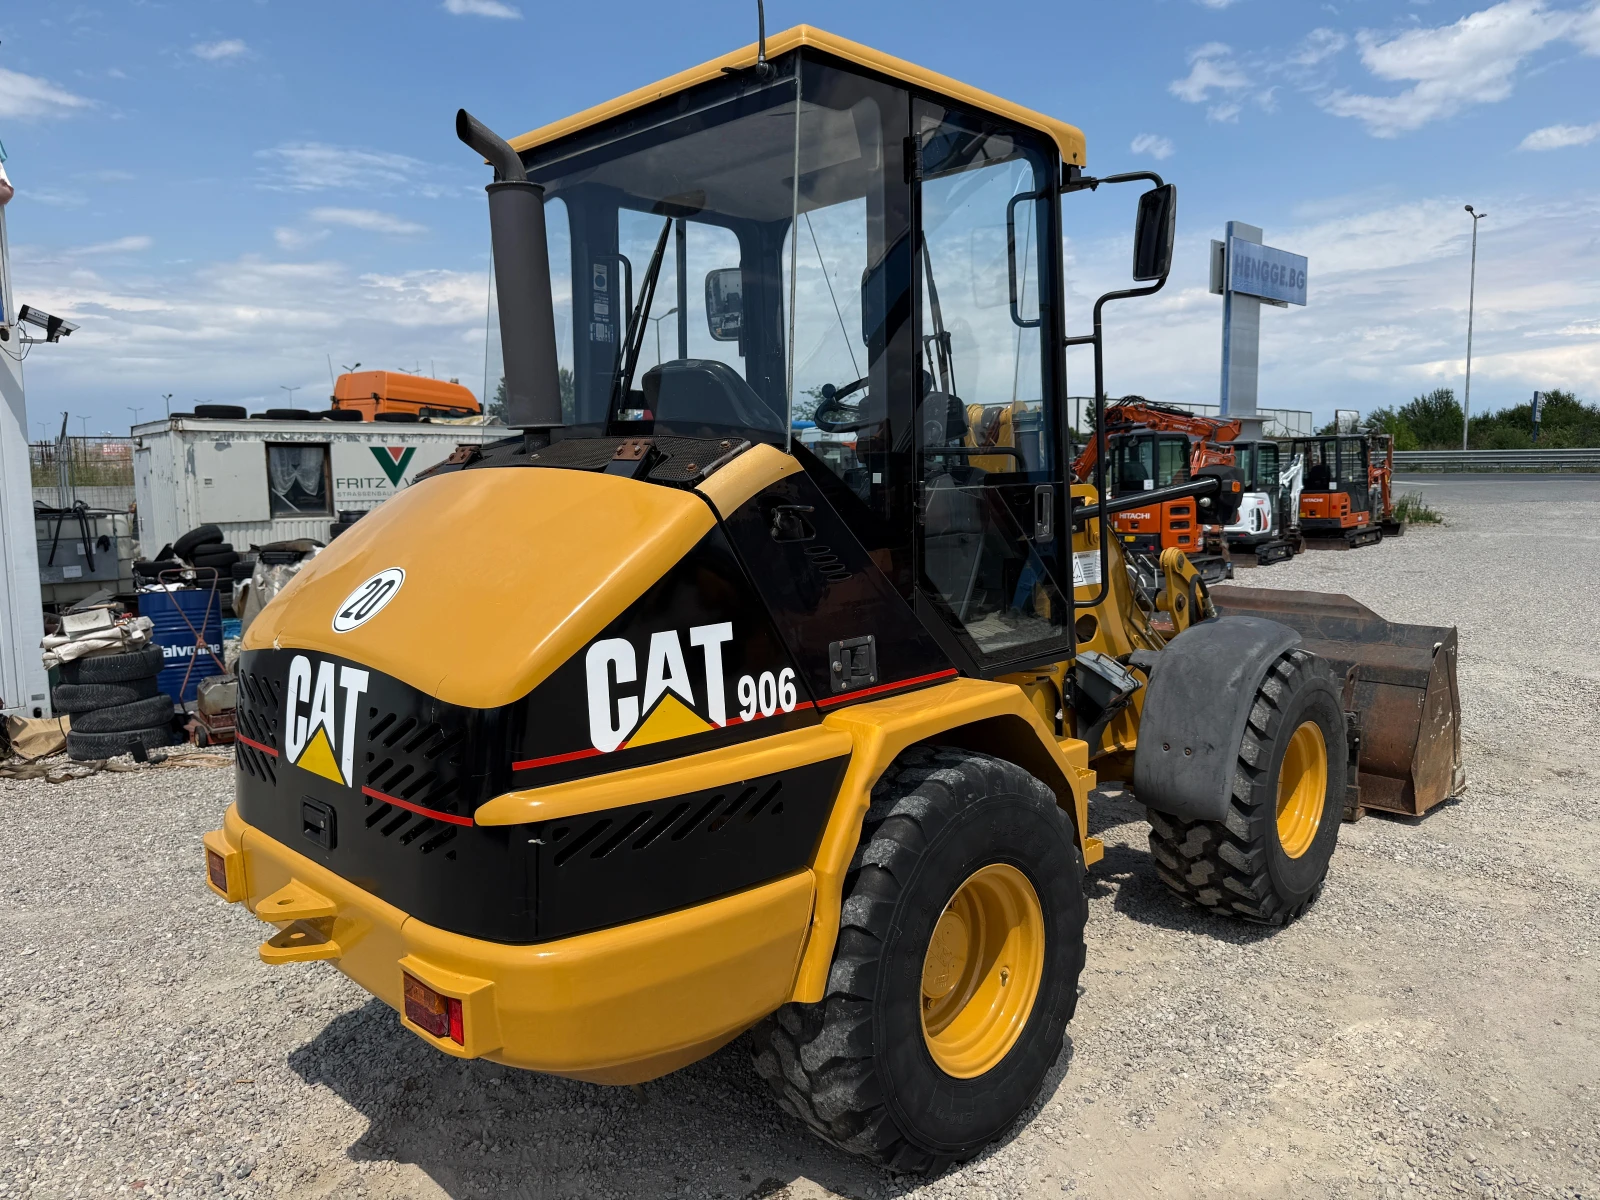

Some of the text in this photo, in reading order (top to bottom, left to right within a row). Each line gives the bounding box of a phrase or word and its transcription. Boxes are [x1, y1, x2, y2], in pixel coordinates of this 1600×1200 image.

[1234, 254, 1305, 290] HENGGE.BG
[336, 477, 387, 489] FRITZ
[1118, 512, 1151, 520] HITACHI
[339, 577, 396, 621] 20
[585, 621, 798, 753] CAT 906
[285, 654, 370, 788] CAT
